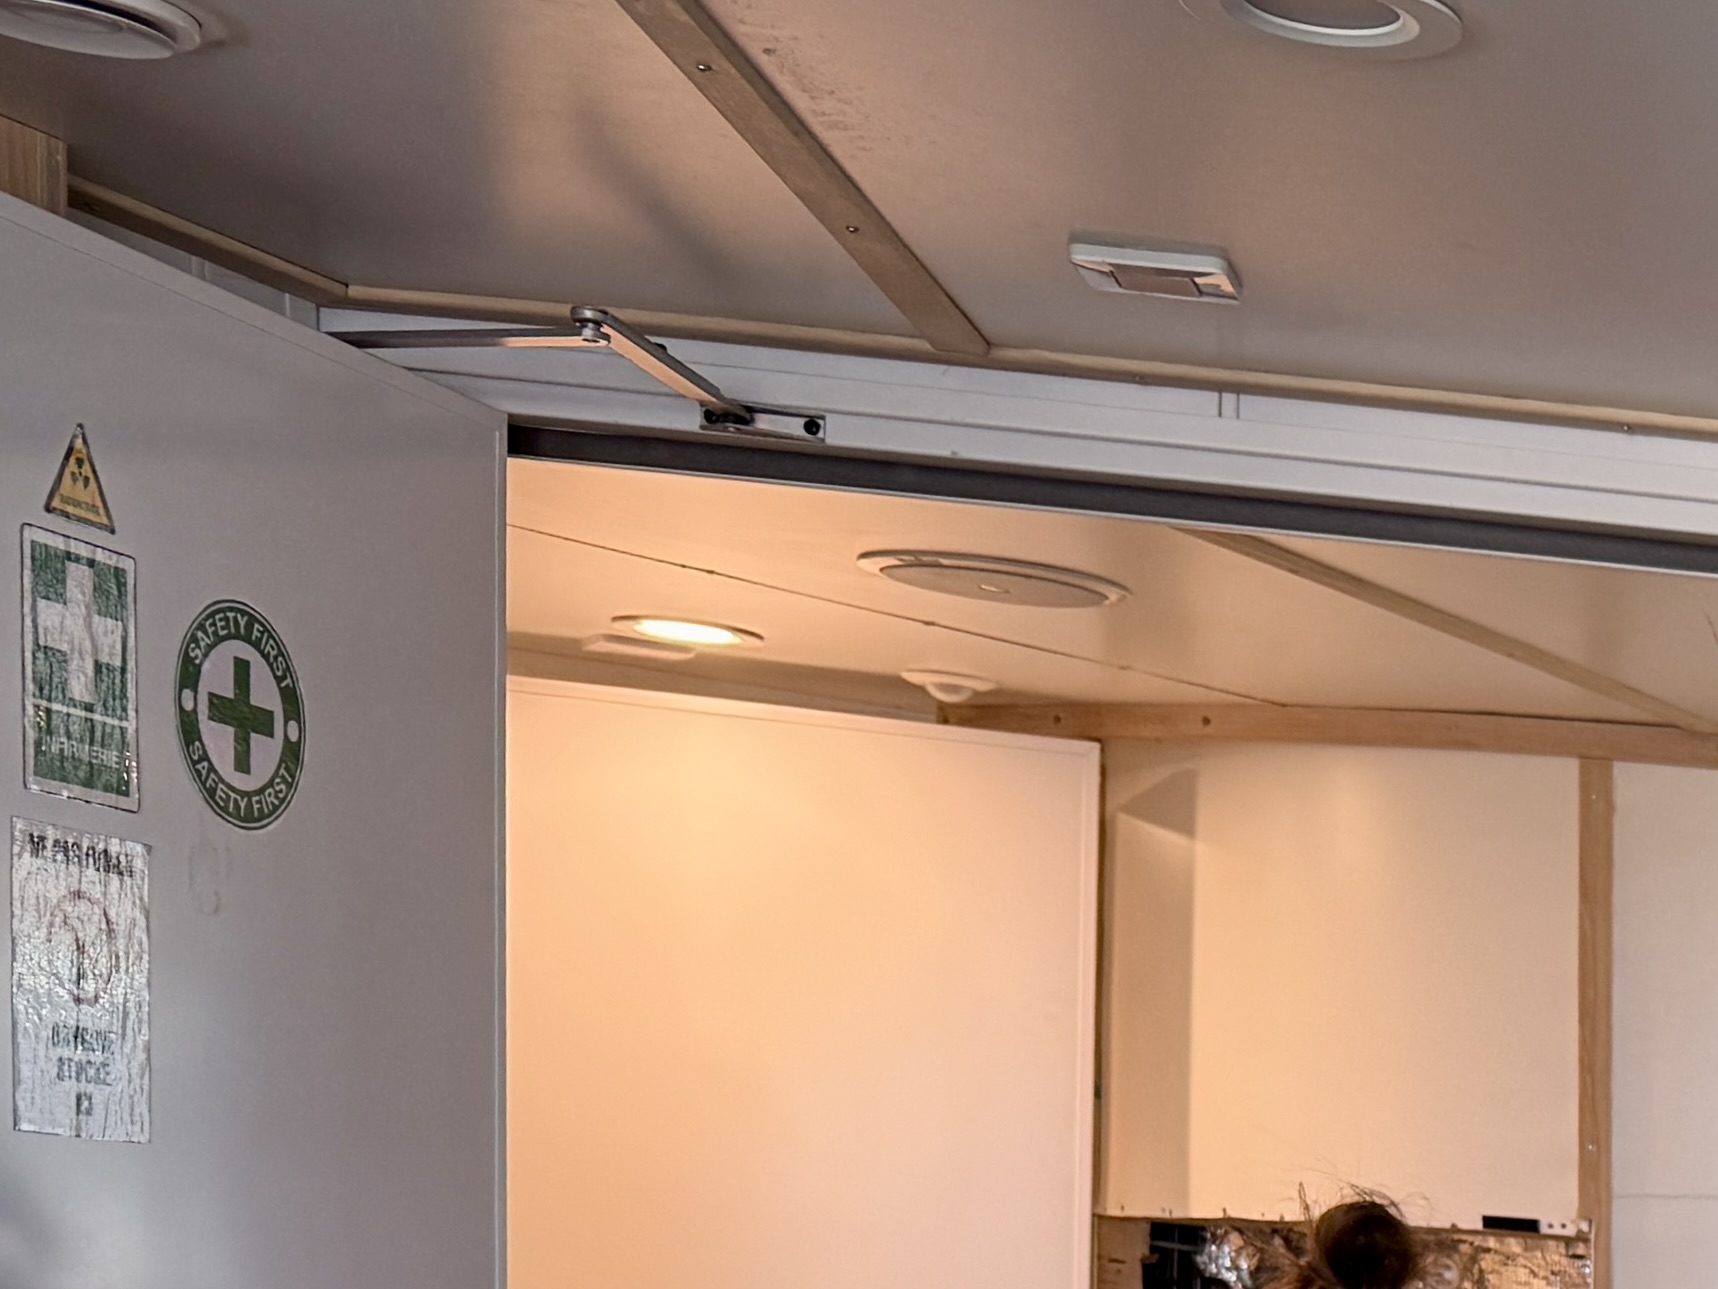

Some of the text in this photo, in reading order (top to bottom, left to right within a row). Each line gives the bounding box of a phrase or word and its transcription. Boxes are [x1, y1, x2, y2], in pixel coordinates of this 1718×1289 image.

[188, 611, 293, 689] SAFETY FIRST
[189, 741, 292, 818] SAFETY FIRST
